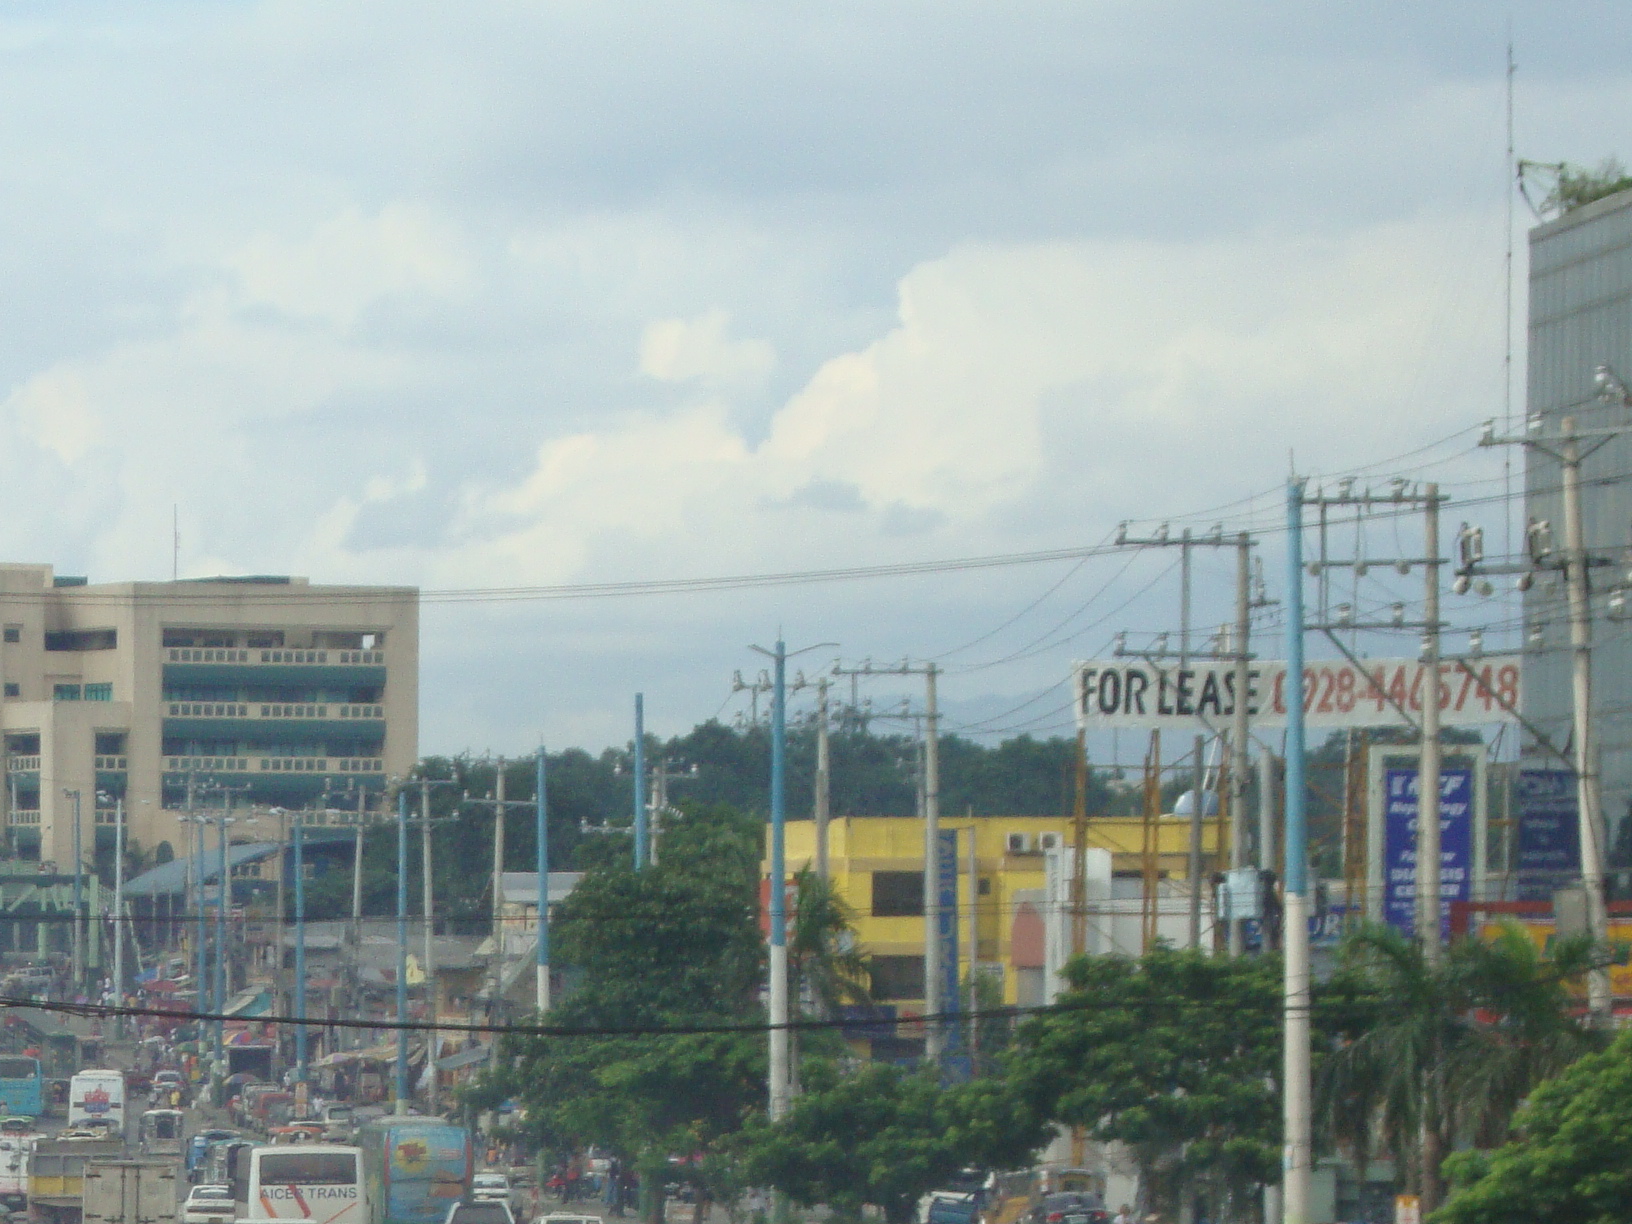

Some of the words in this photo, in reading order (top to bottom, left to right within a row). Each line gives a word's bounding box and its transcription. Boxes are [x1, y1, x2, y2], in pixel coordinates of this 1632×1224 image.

[1082, 667, 1147, 715] FOR
[1157, 669, 1261, 716] LEASE
[308, 1187, 358, 1199] TRANS
